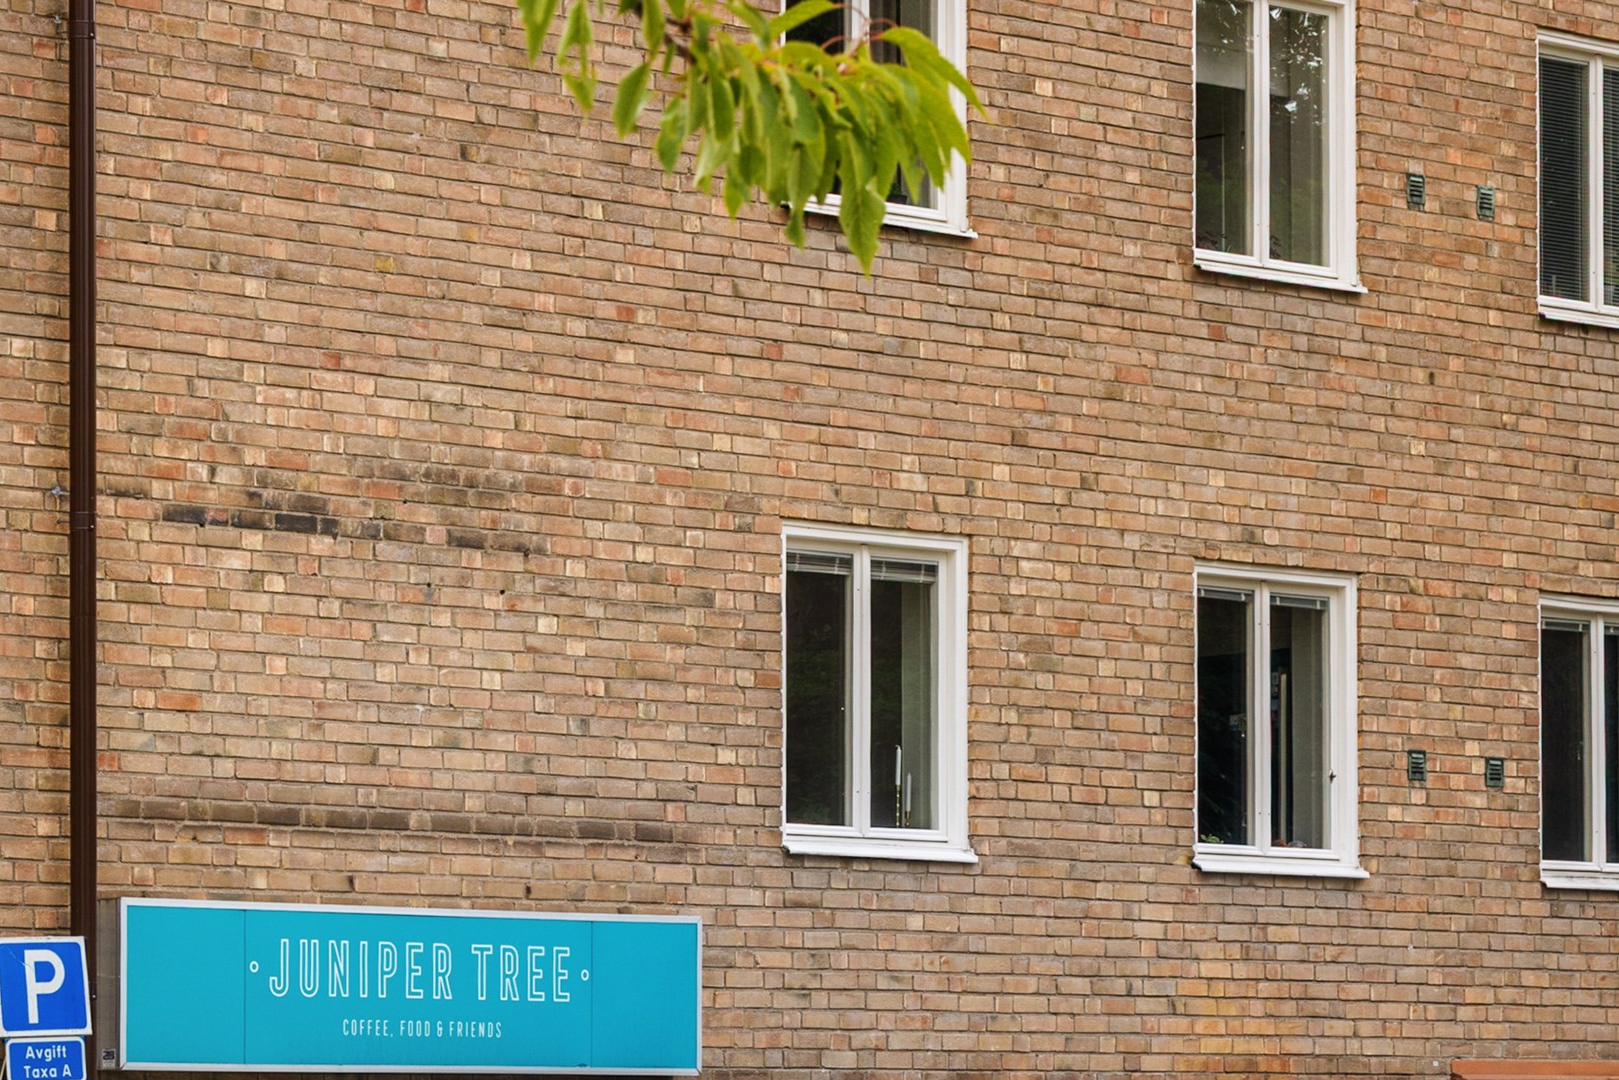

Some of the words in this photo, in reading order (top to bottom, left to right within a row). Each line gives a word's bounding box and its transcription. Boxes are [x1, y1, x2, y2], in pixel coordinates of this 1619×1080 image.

[269, 938, 453, 999] JUNIPER
[471, 944, 571, 1003] TREE
[24, 948, 66, 1024] P
[342, 1018, 394, 1038] COFFEE,
[400, 1020, 431, 1037] FOOD
[436, 1020, 443, 1037] &
[449, 1021, 502, 1039] FRIENDS
[25, 1044, 67, 1063] Avgift
[23, 1065, 58, 1079] Taxa
[62, 1063, 72, 1078] A
